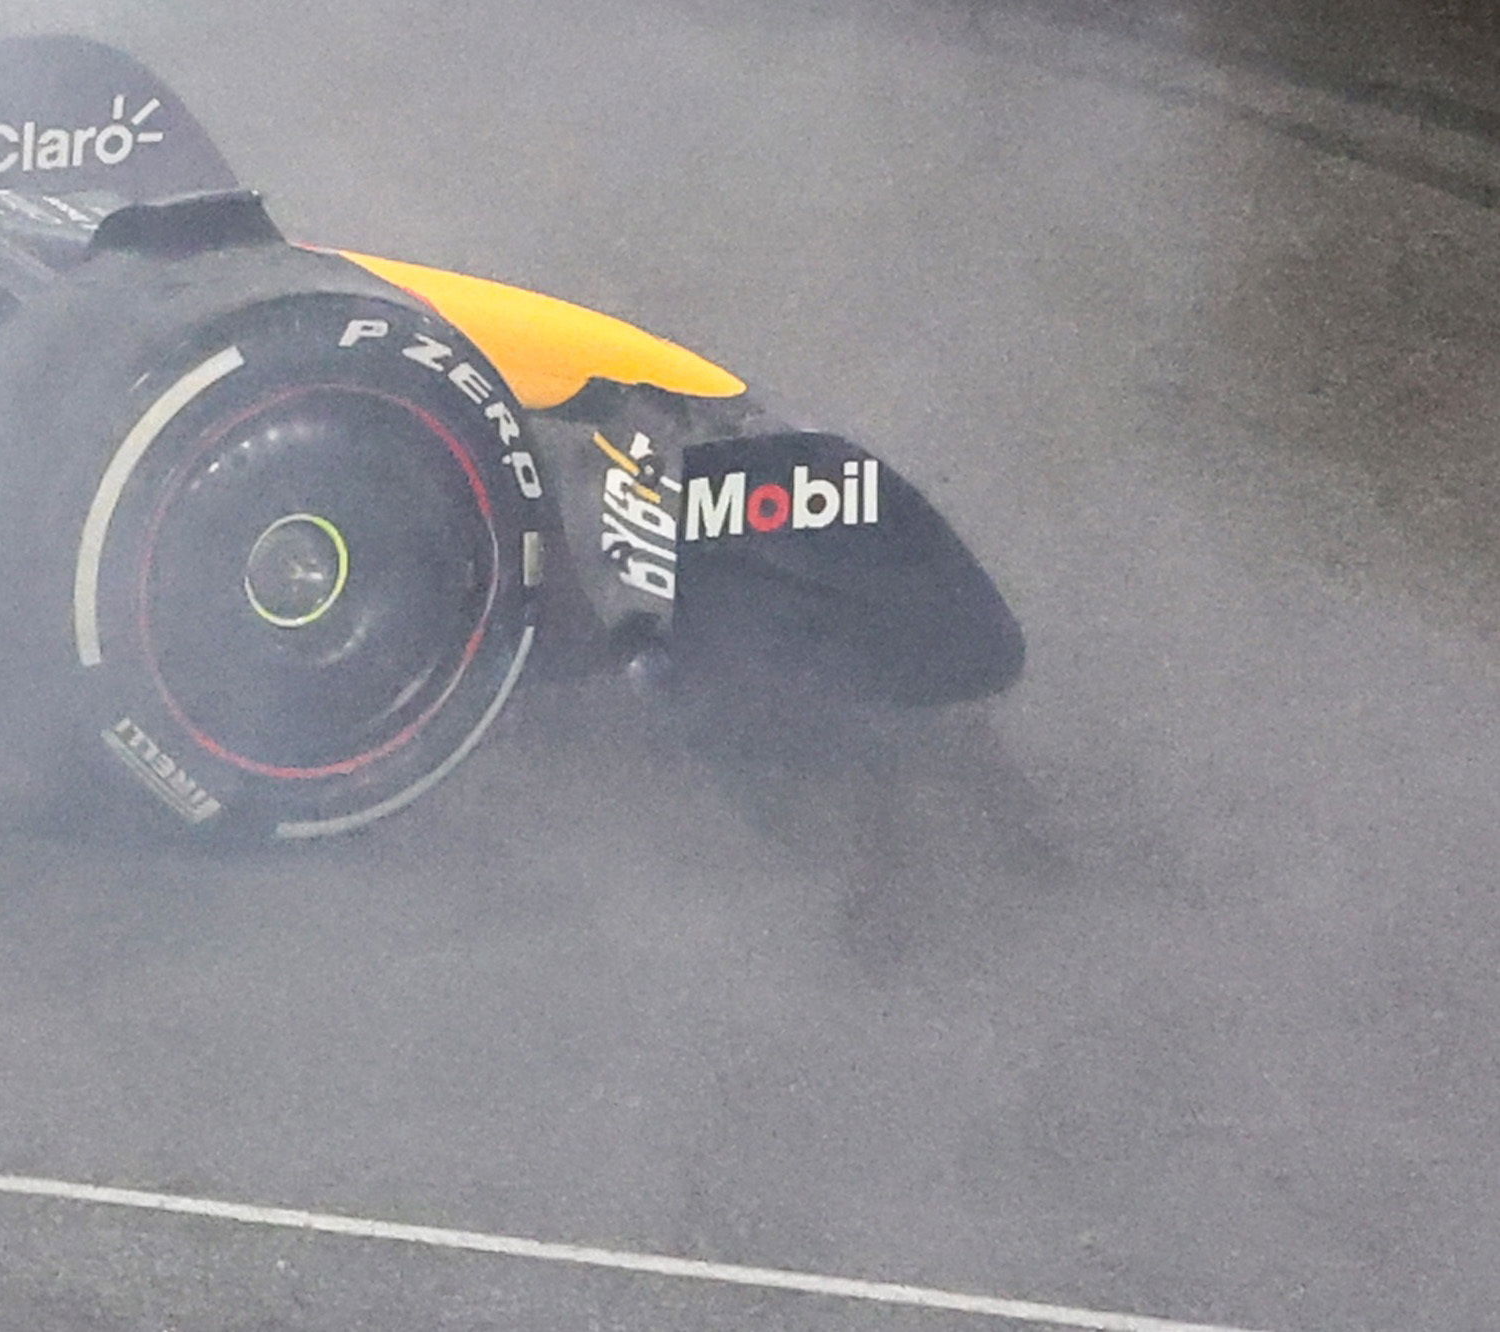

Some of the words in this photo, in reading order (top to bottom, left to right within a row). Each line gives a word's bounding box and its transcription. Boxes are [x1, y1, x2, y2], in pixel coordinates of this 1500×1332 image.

[338, 319, 390, 347] P
[402, 332, 543, 499] ZERO
[685, 459, 879, 541] Mobil
